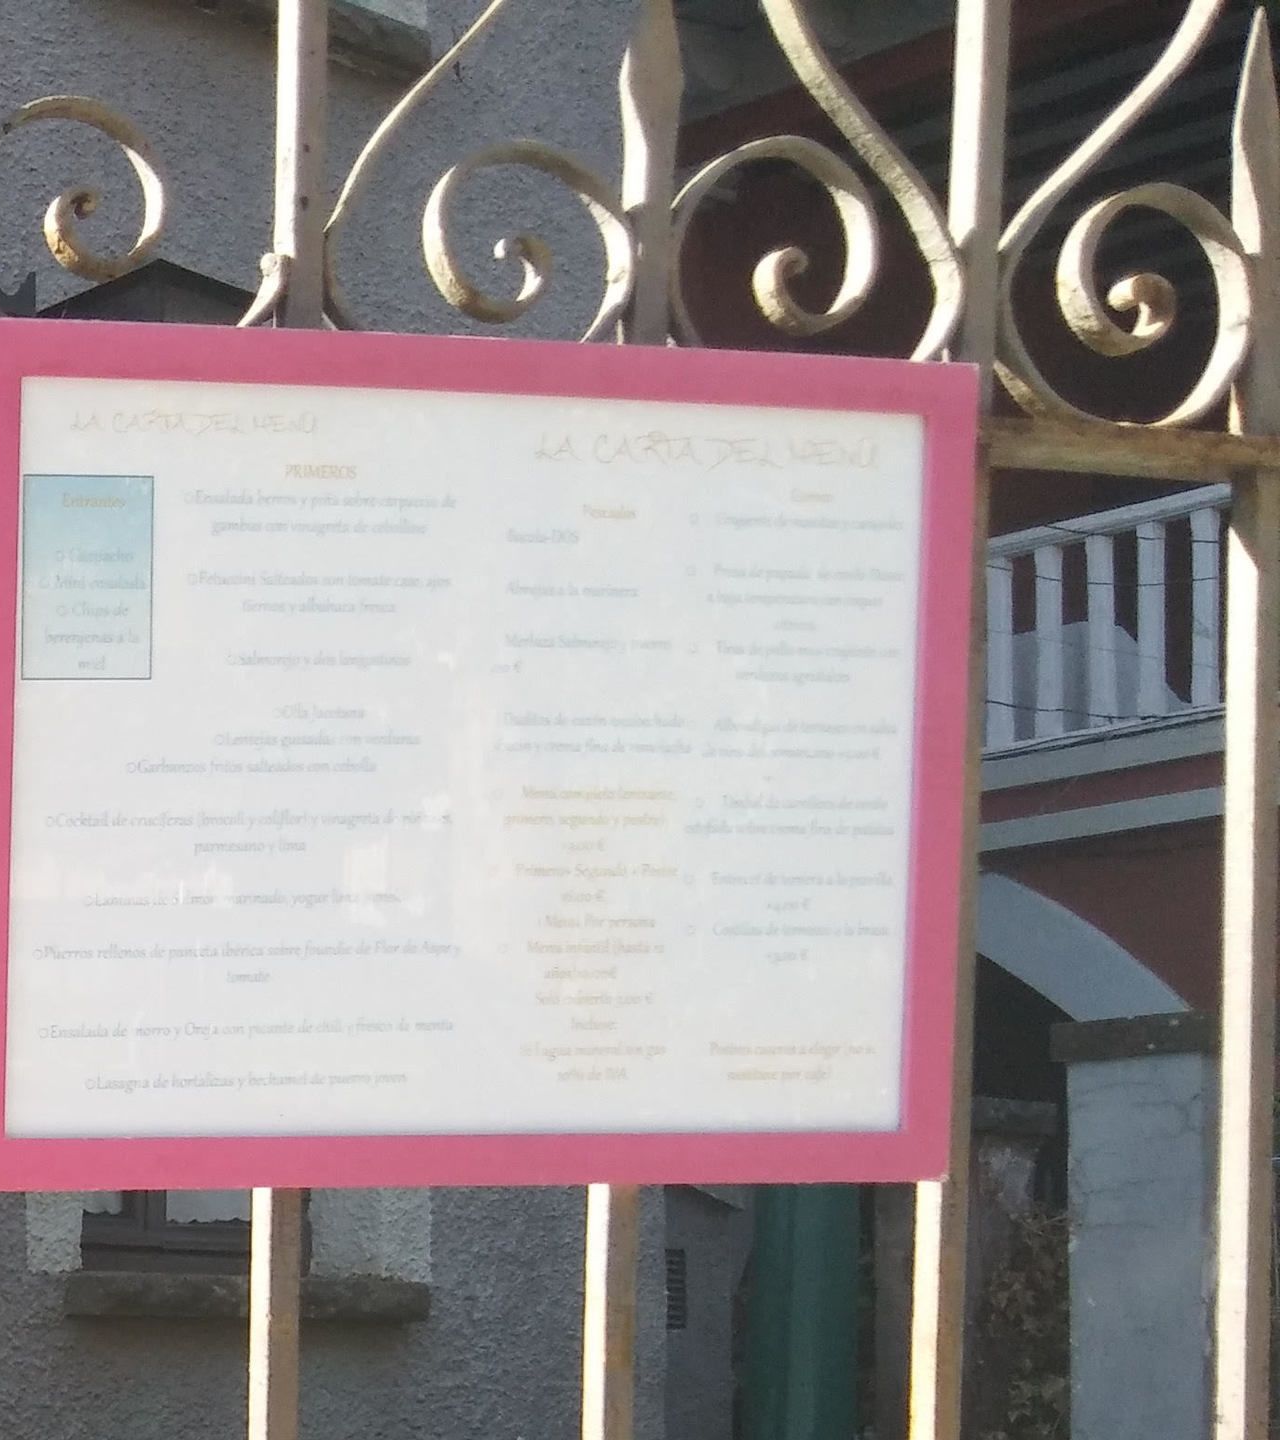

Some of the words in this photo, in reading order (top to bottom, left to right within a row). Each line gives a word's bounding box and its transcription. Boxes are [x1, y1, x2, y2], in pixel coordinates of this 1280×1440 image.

[285, 464, 358, 480] PRIMEROS
[62, 492, 127, 508] Entrantes
[77, 655, 107, 671] miel
[137, 757, 207, 773] Garbanzos
[208, 759, 243, 776] fritos
[246, 758, 305, 773] salteados
[55, 811, 109, 828] Cocktail
[111, 812, 129, 827] de
[320, 811, 380, 830] vinagreta
[193, 841, 265, 857] parmesano
[43, 945, 93, 960] Puerros
[96, 942, 147, 960] rellenos
[149, 944, 165, 959] de
[168, 945, 219, 966] panceta
[266, 941, 301, 956] sobre
[226, 968, 271, 984] tomate
[50, 1022, 109, 1038] Ensalada
[111, 1021, 129, 1037] de
[184, 1021, 219, 1040] Oreja
[221, 1025, 246, 1037] con
[95, 1074, 150, 1094] Lasagna
[151, 1072, 170, 1089] de
[171, 1071, 235, 1089] hortalizas
[248, 1070, 308, 1087] bechamel
[309, 1071, 327, 1086] de
[328, 1072, 371, 1090] puerro
